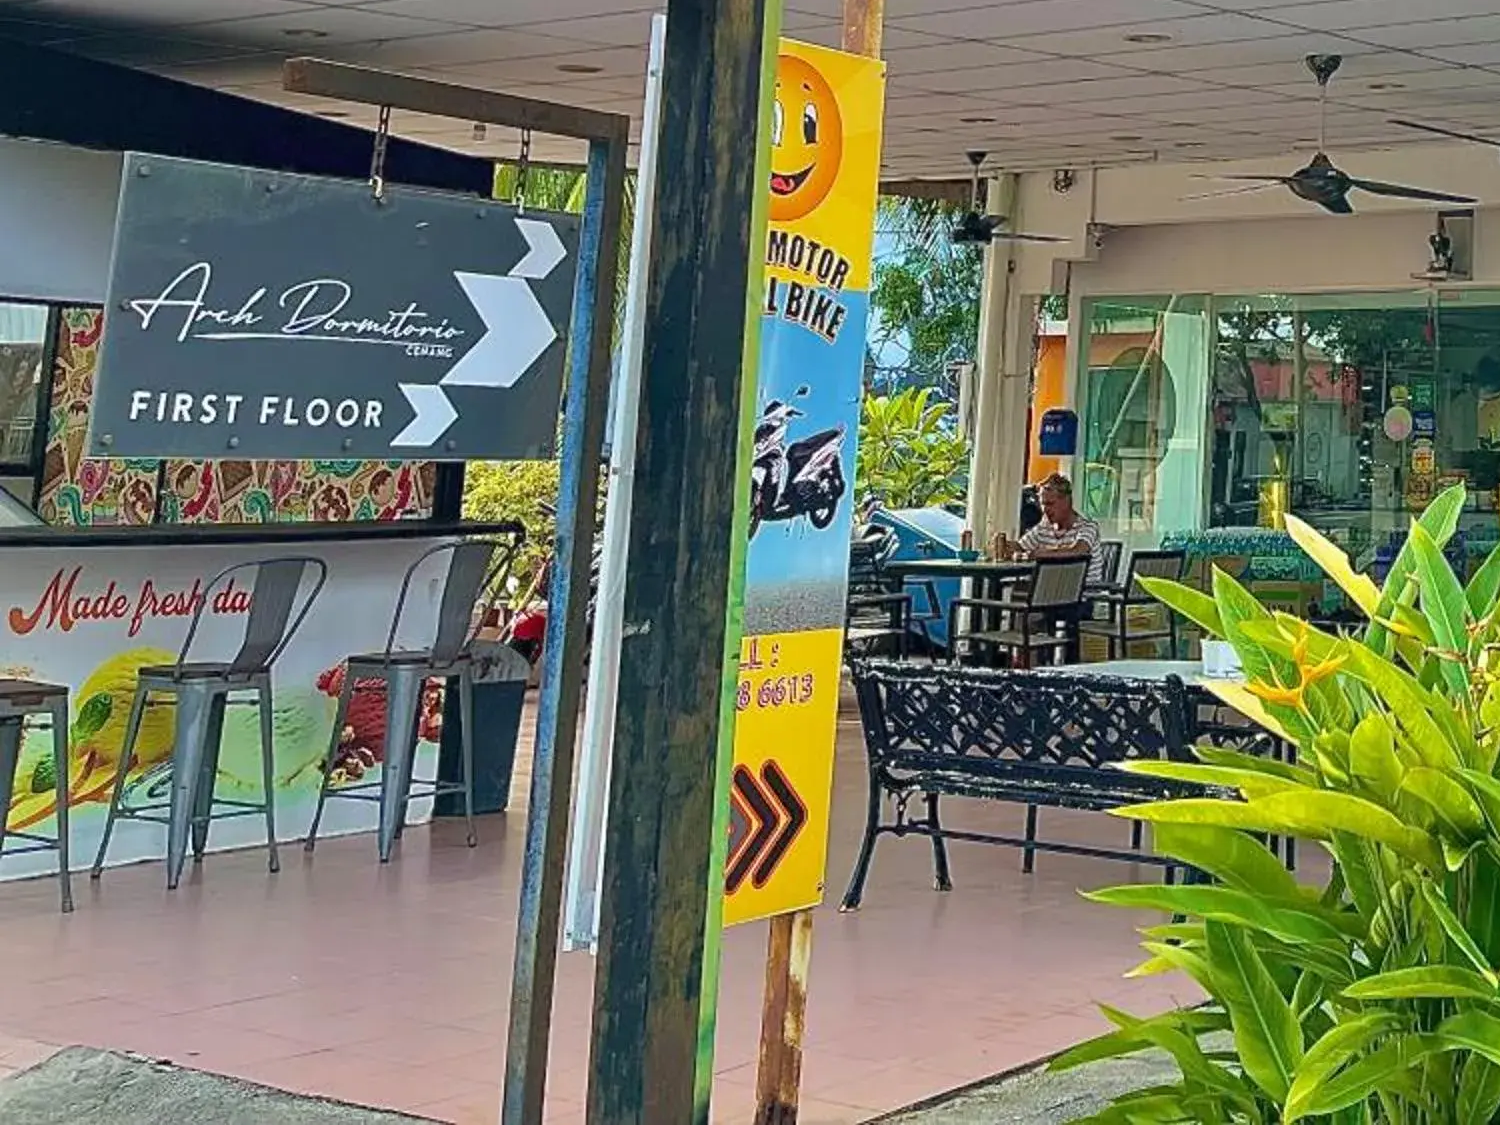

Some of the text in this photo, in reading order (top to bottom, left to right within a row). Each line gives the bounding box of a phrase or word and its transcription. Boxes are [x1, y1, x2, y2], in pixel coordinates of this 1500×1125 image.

[767, 229, 851, 291] MOTOR
[131, 262, 465, 342] Arch Dormitorio
[785, 284, 847, 341] BIKE
[129, 389, 383, 430] FIRST FLOOR
[9, 565, 130, 635] Made
[127, 577, 206, 638] fresh
[757, 672, 814, 708] 6613
